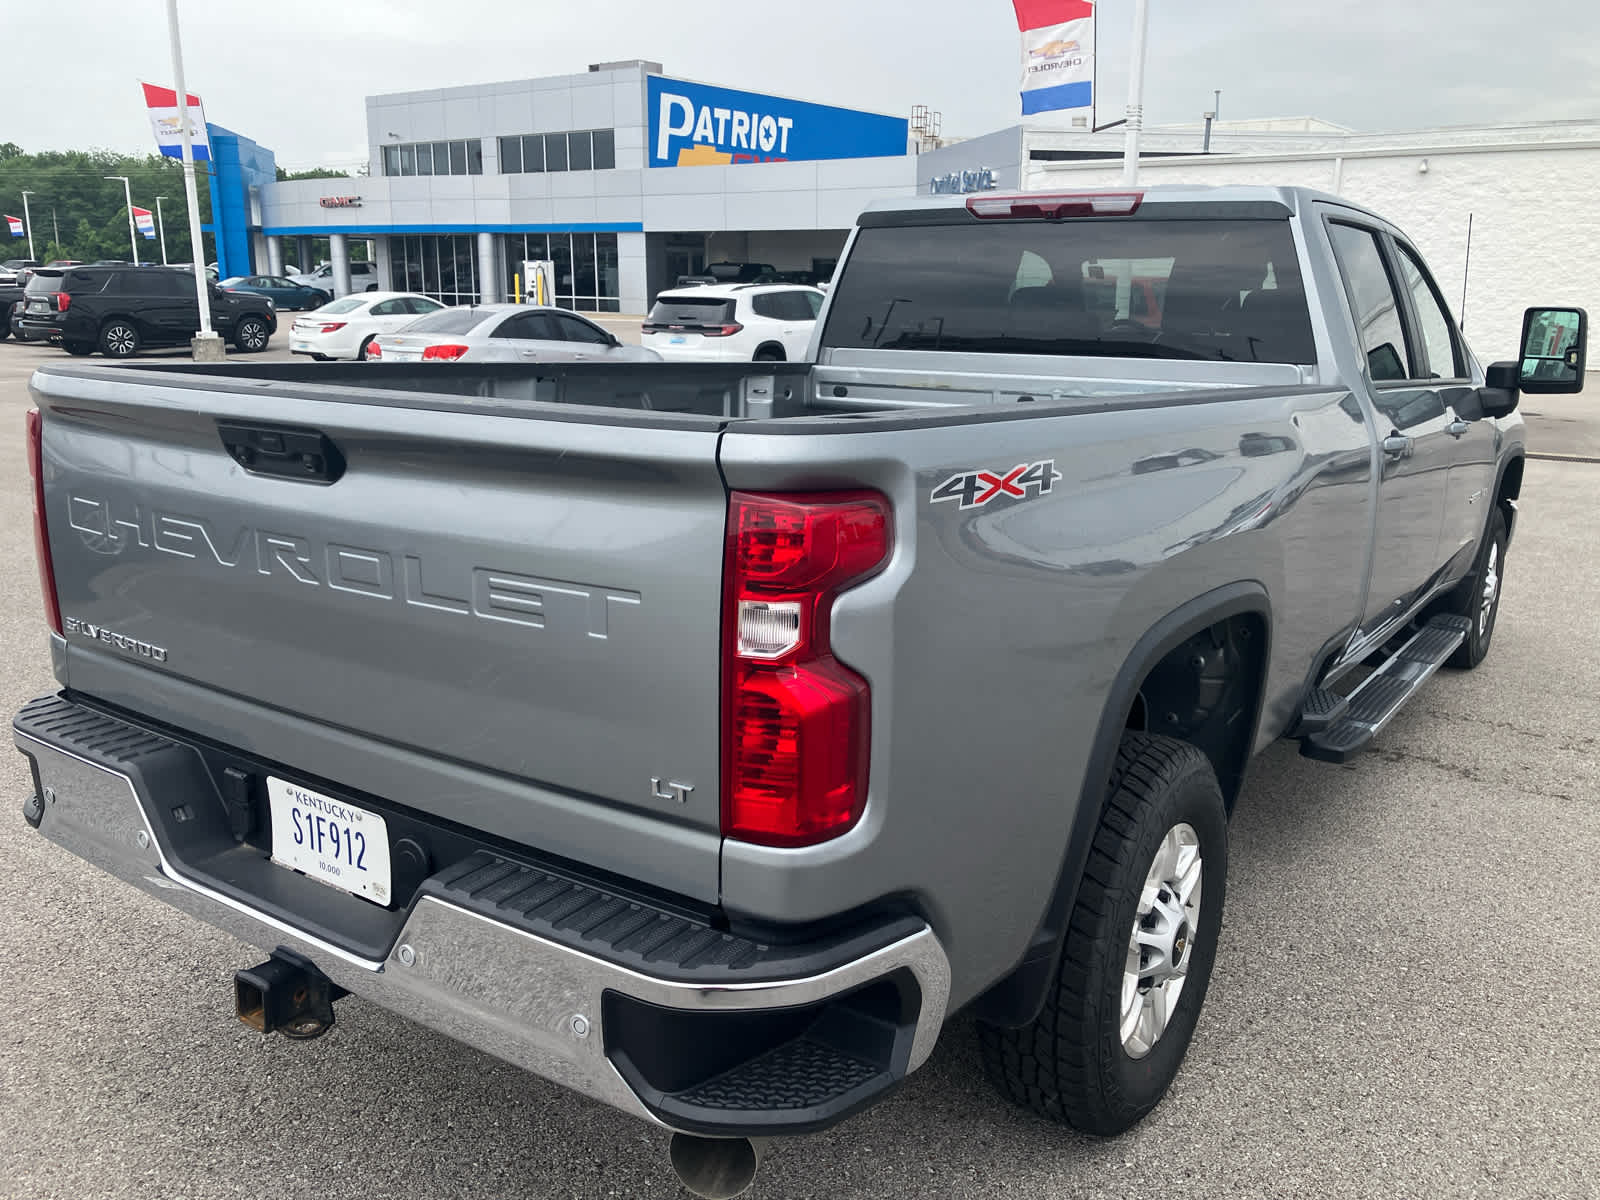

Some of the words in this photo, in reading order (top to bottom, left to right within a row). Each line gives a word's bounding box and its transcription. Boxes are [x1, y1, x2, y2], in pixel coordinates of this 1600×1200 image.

[657, 92, 793, 161] PATRIOT
[319, 196, 362, 208] GMC
[67, 494, 641, 640] CHEVROLET
[65, 616, 168, 662] SILVERADO
[295, 791, 355, 823] KENTUCKY
[650, 777, 695, 804] LT
[292, 807, 368, 872] S1F912
[319, 860, 342, 876] 10,000
